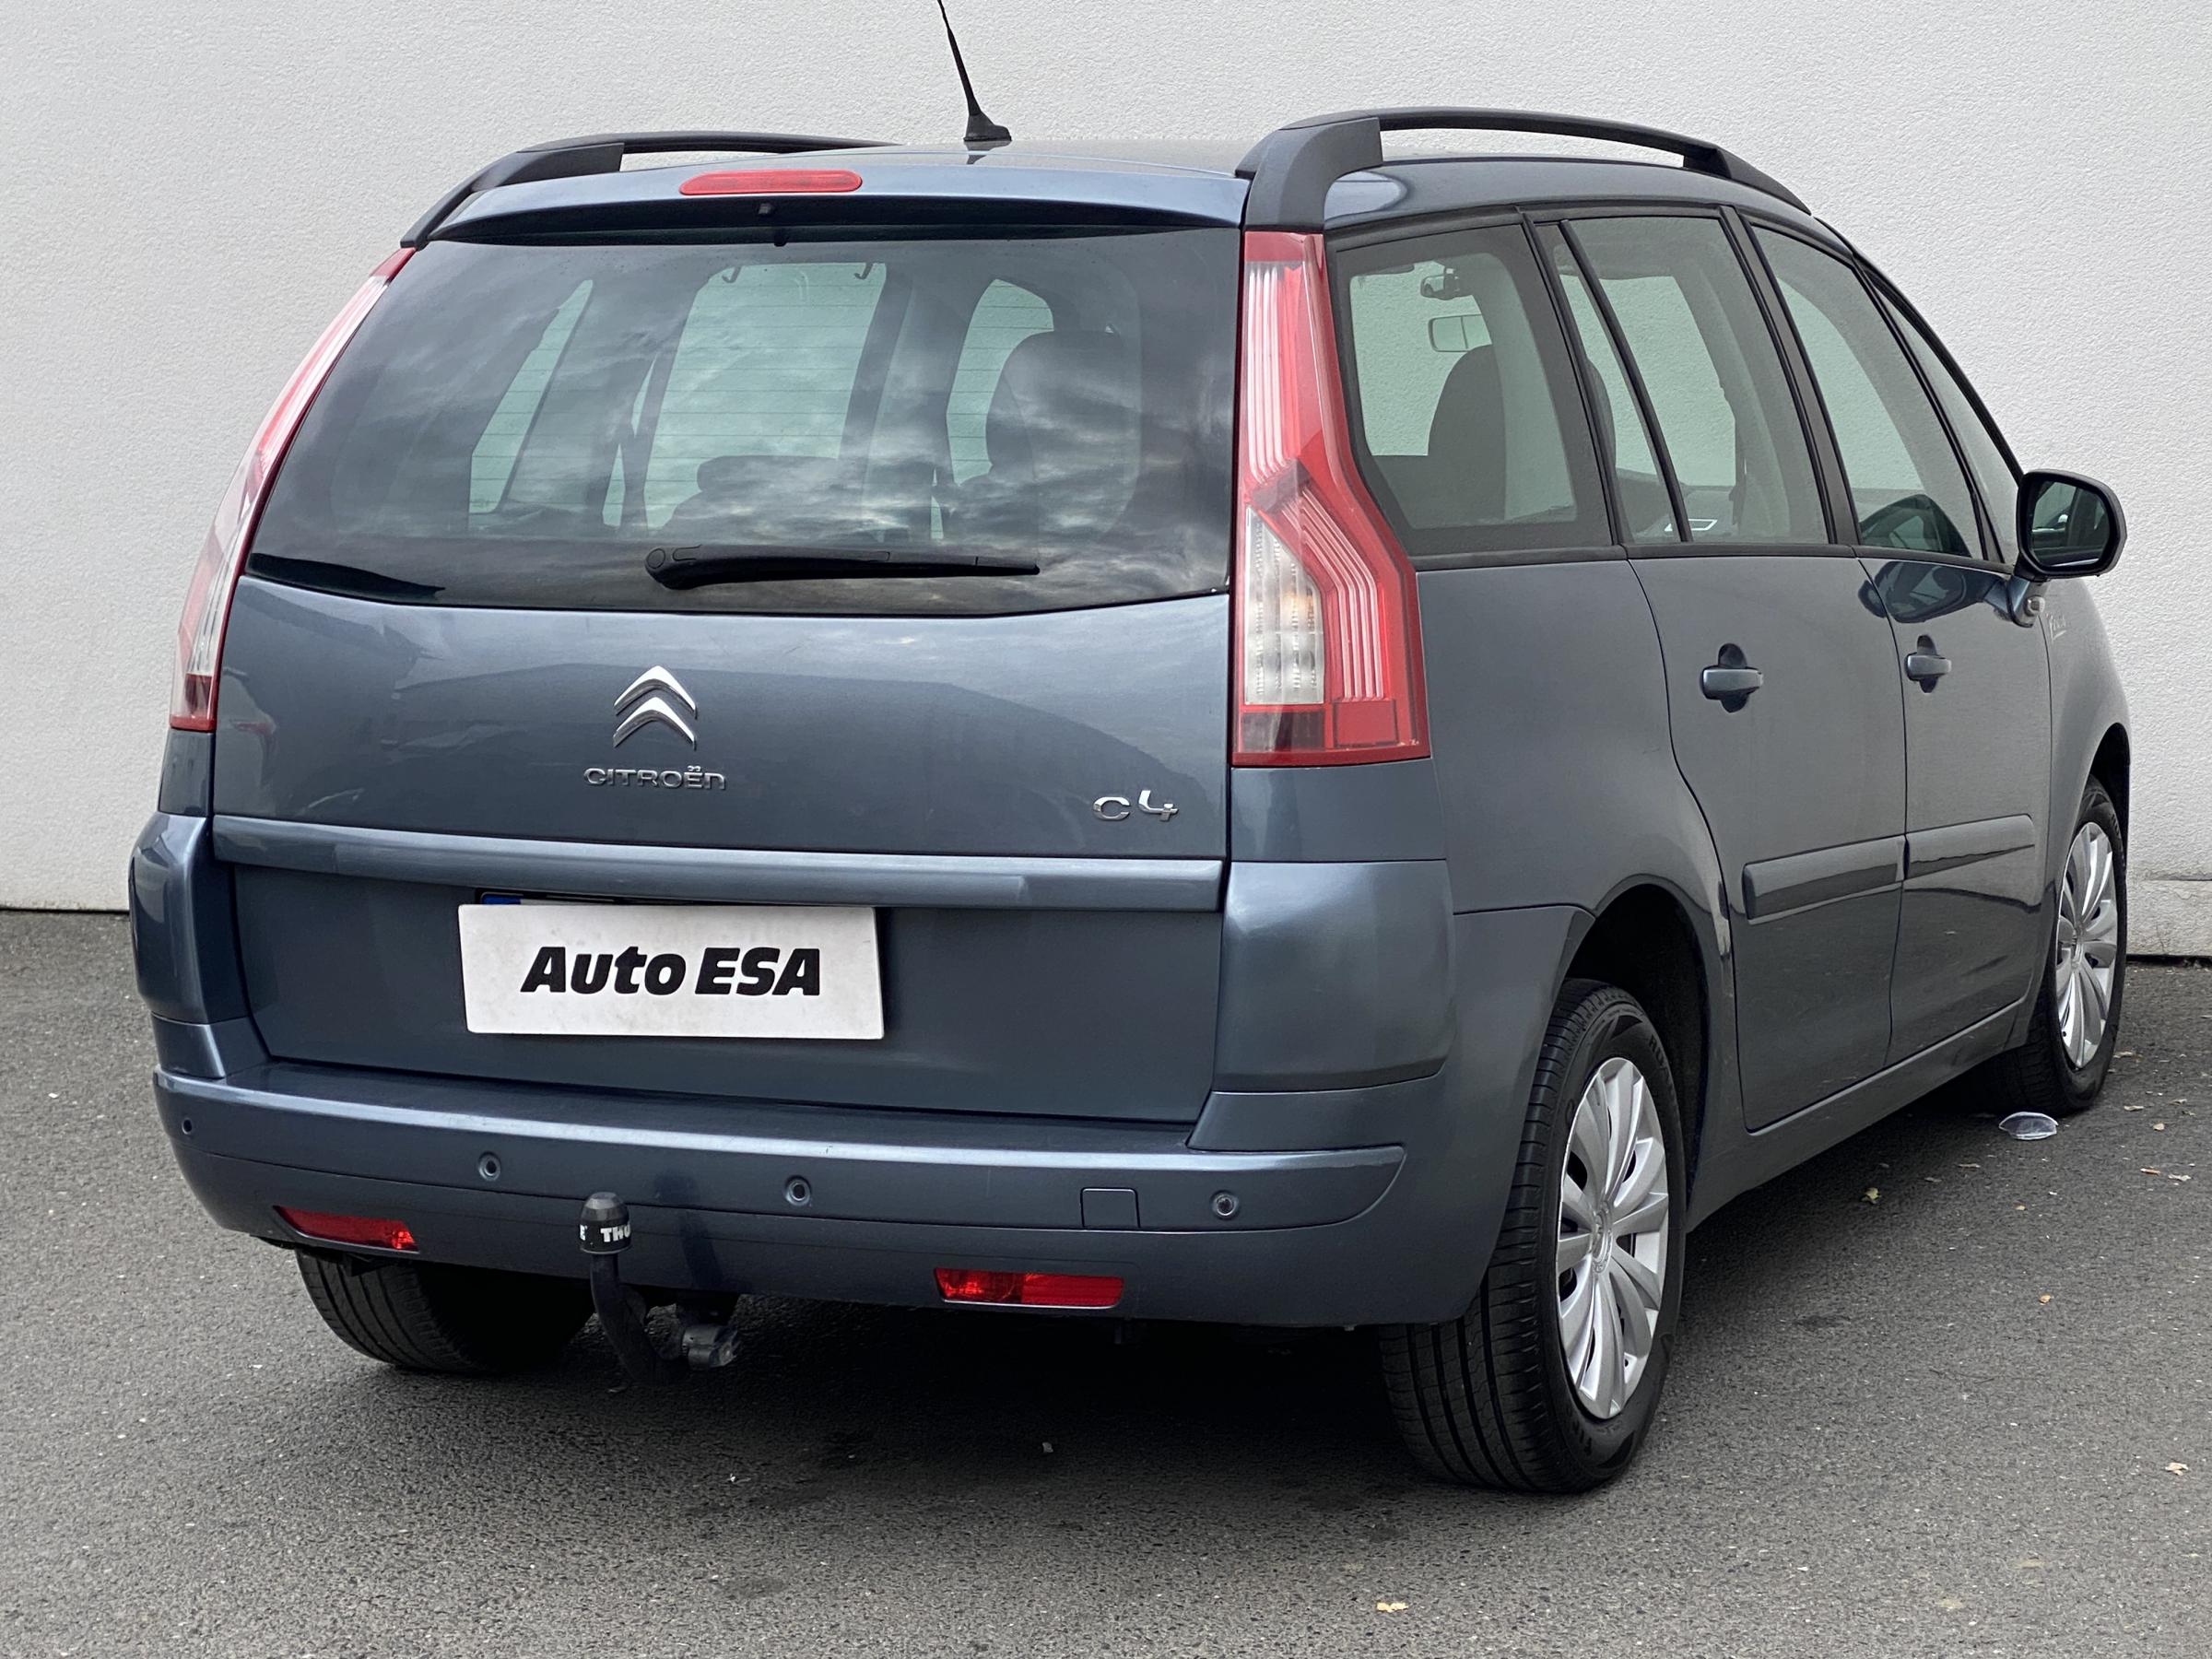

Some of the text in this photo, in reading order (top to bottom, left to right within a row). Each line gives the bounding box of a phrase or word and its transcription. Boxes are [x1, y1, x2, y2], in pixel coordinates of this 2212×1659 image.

[1092, 789, 1180, 821] C4
[519, 946, 821, 997] Auto ESA
